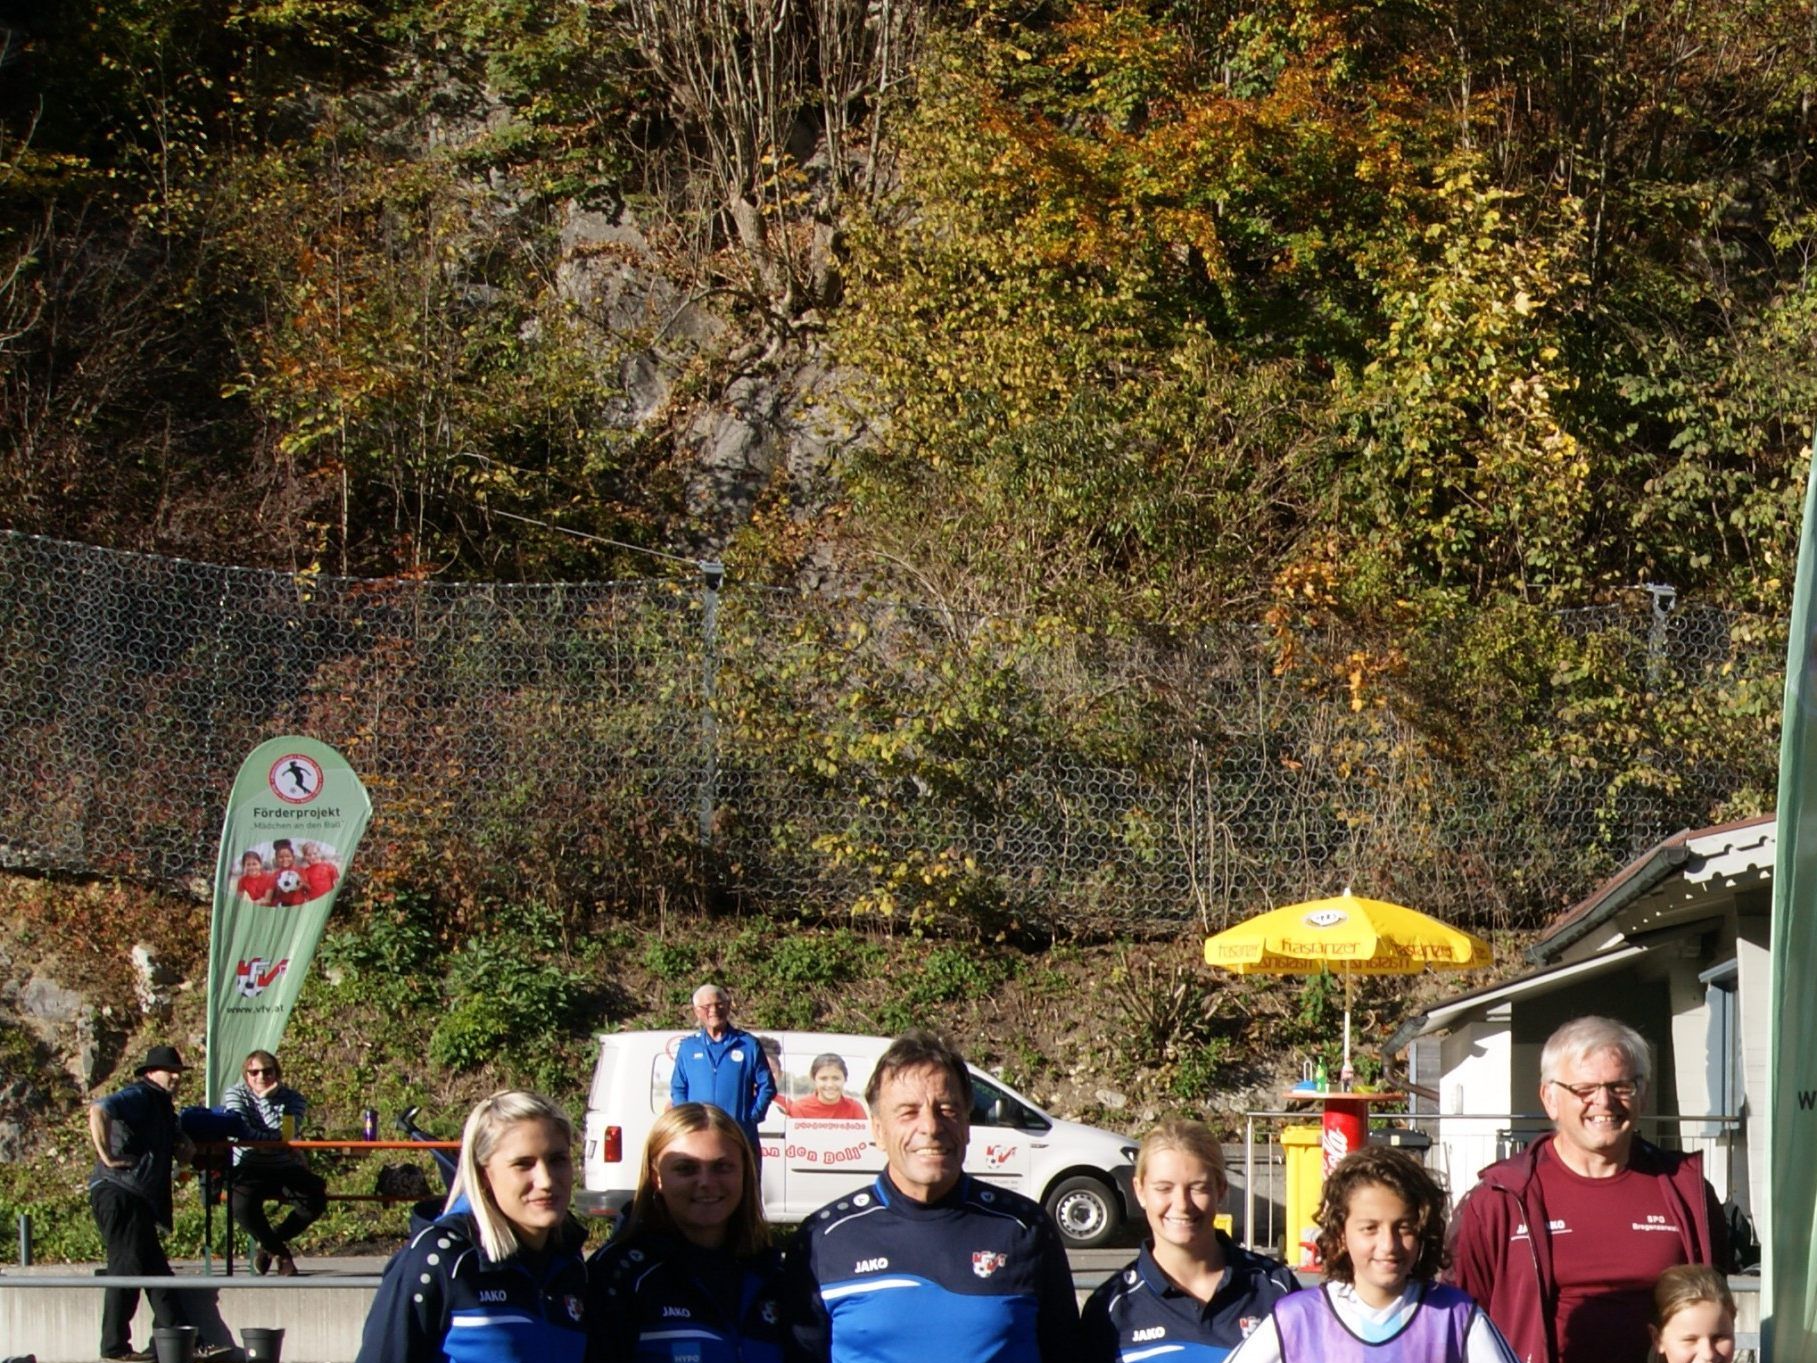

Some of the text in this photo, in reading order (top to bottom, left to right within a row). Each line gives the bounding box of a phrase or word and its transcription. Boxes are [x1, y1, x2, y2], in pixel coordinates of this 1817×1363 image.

[253, 806, 341, 819] Förderprojekt
[854, 1257, 889, 1274] JAKO
[480, 1289, 508, 1302] JAKO
[662, 1305, 692, 1318] JAKO
[1131, 1326, 1166, 1342] JAKO
